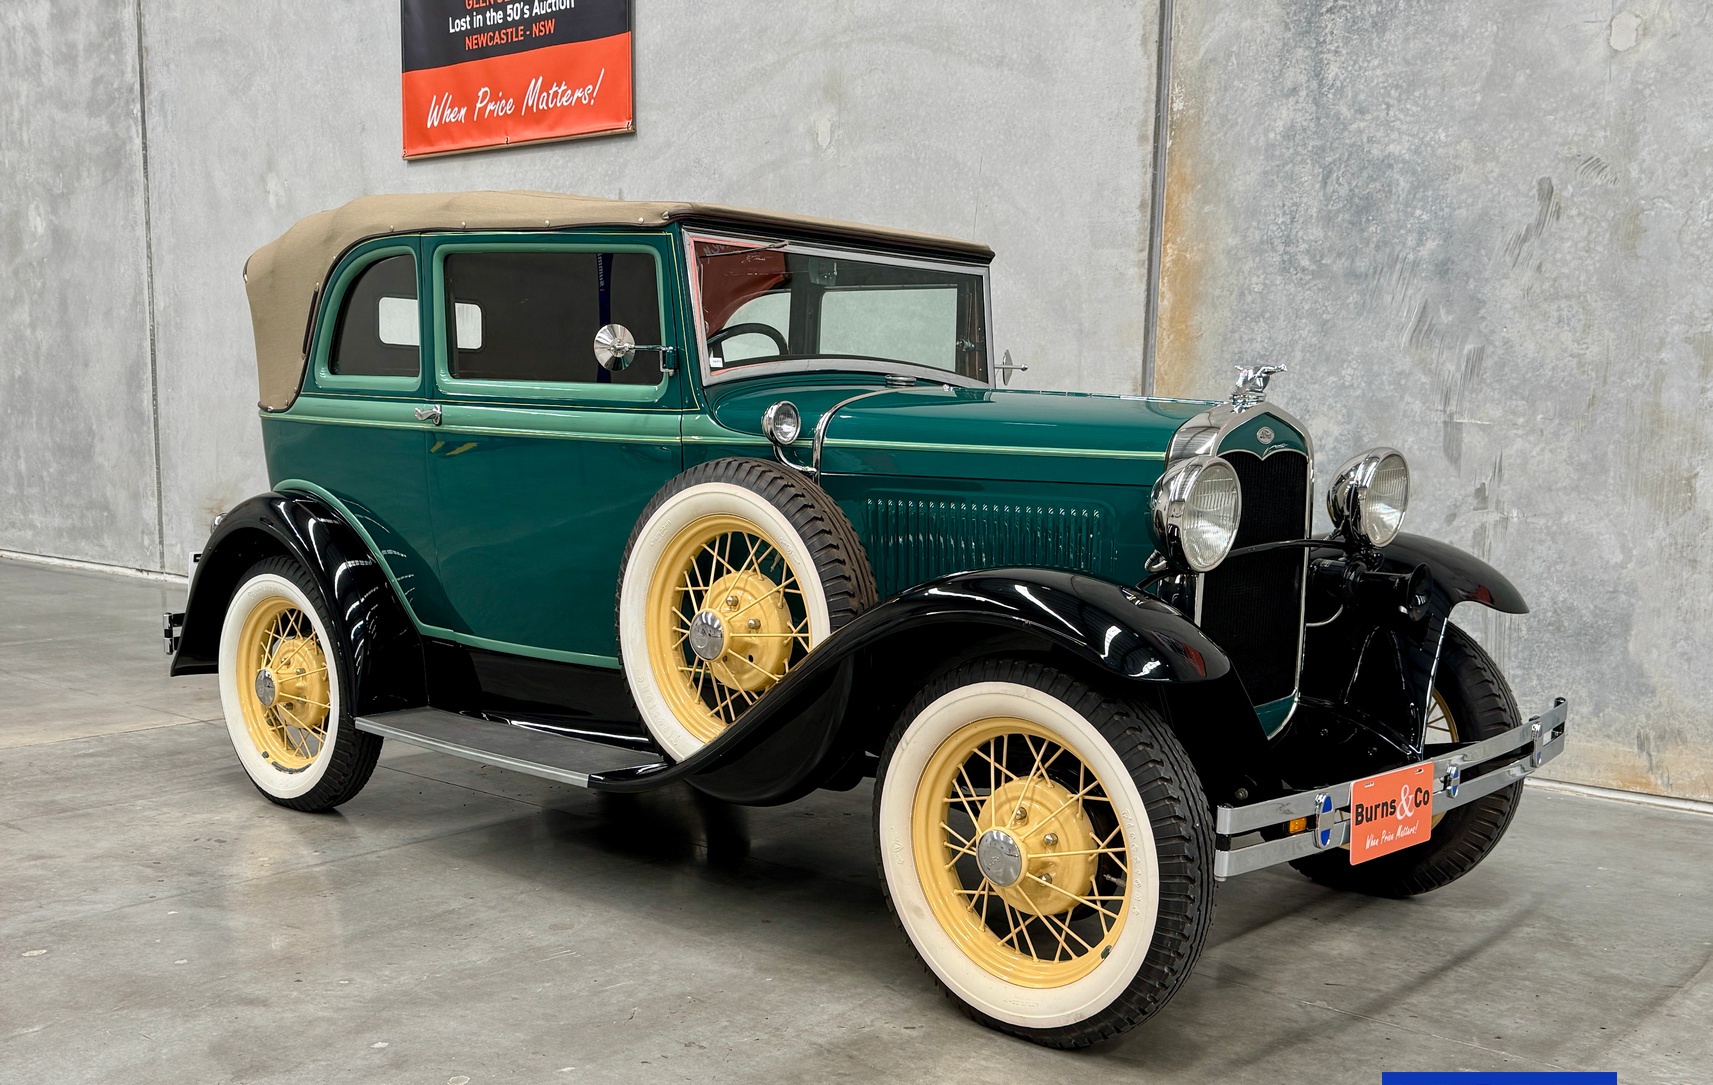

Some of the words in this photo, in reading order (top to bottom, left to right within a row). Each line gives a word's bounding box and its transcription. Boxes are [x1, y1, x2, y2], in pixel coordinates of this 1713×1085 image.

[449, 14, 471, 33] Lost
[473, 11, 483, 28] in
[486, 8, 504, 26] the
[506, 3, 530, 22] 50's
[532, 0, 575, 16] Auction
[465, 25, 524, 51] NEWCASTLE
[532, 18, 555, 38] NSW
[426, 92, 467, 129] When
[474, 86, 515, 122] Price
[521, 68, 605, 117] Matters!
[1381, 829, 1395, 845] Price
[1396, 820, 1419, 841] Matters!
